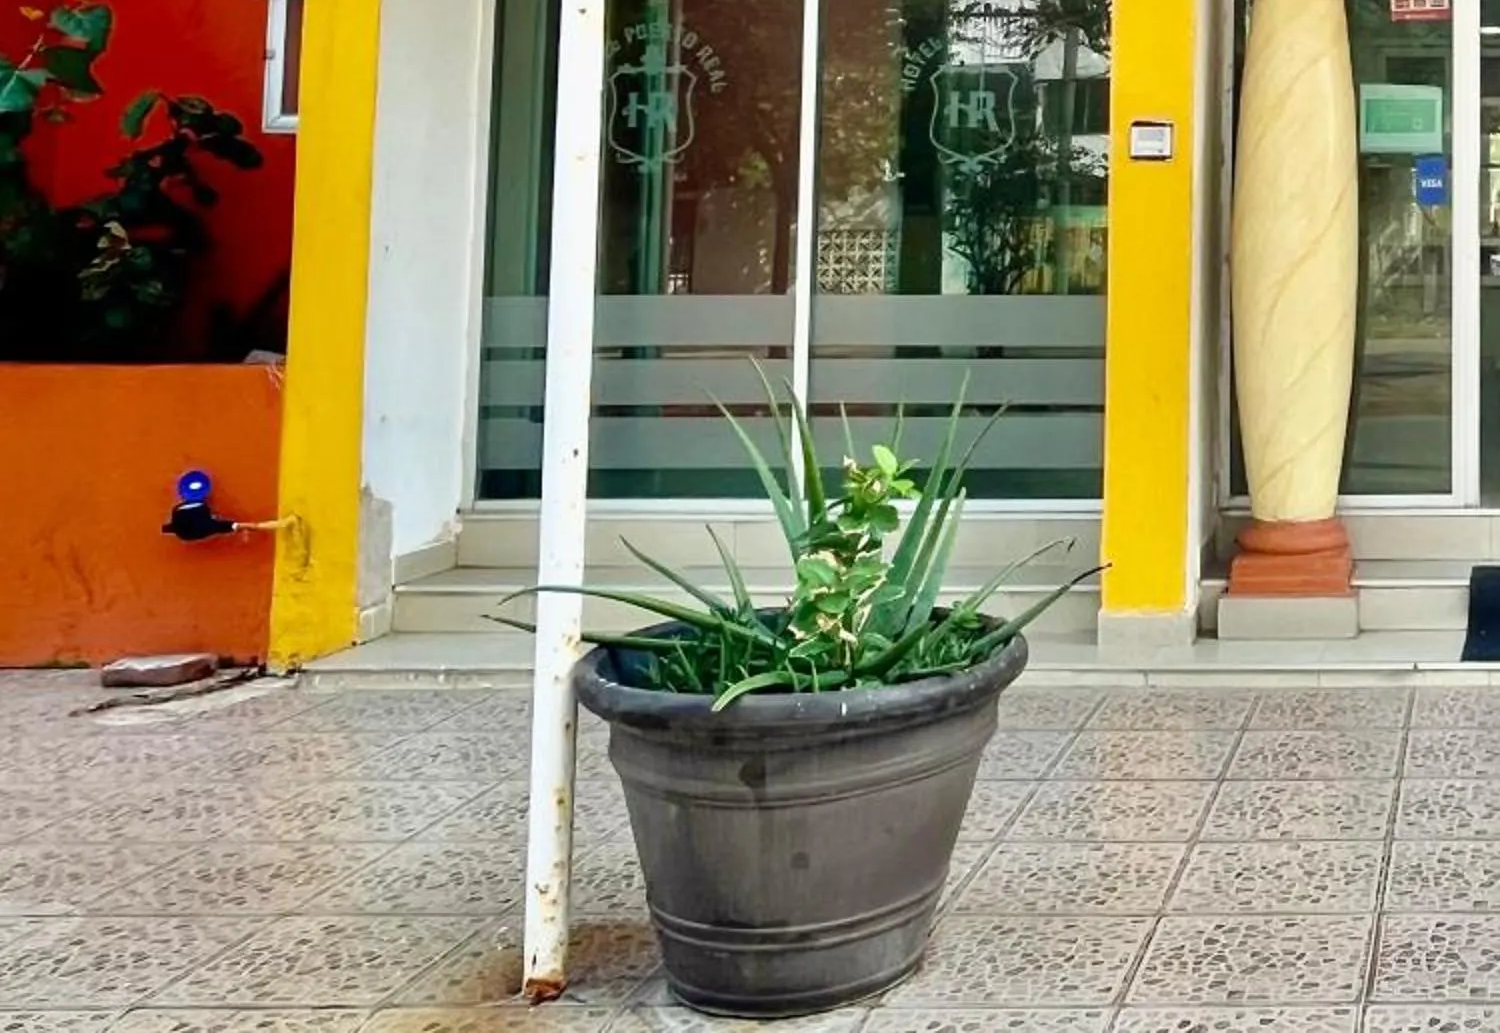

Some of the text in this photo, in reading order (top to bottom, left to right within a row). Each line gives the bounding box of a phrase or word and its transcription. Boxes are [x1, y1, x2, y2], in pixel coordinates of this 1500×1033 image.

[624, 22, 698, 50] PUERO
[696, 45, 728, 94] REAL
[900, 36, 943, 92] HOTEL
[943, 90, 1001, 133] HR
[1421, 178, 1443, 188] VISA
